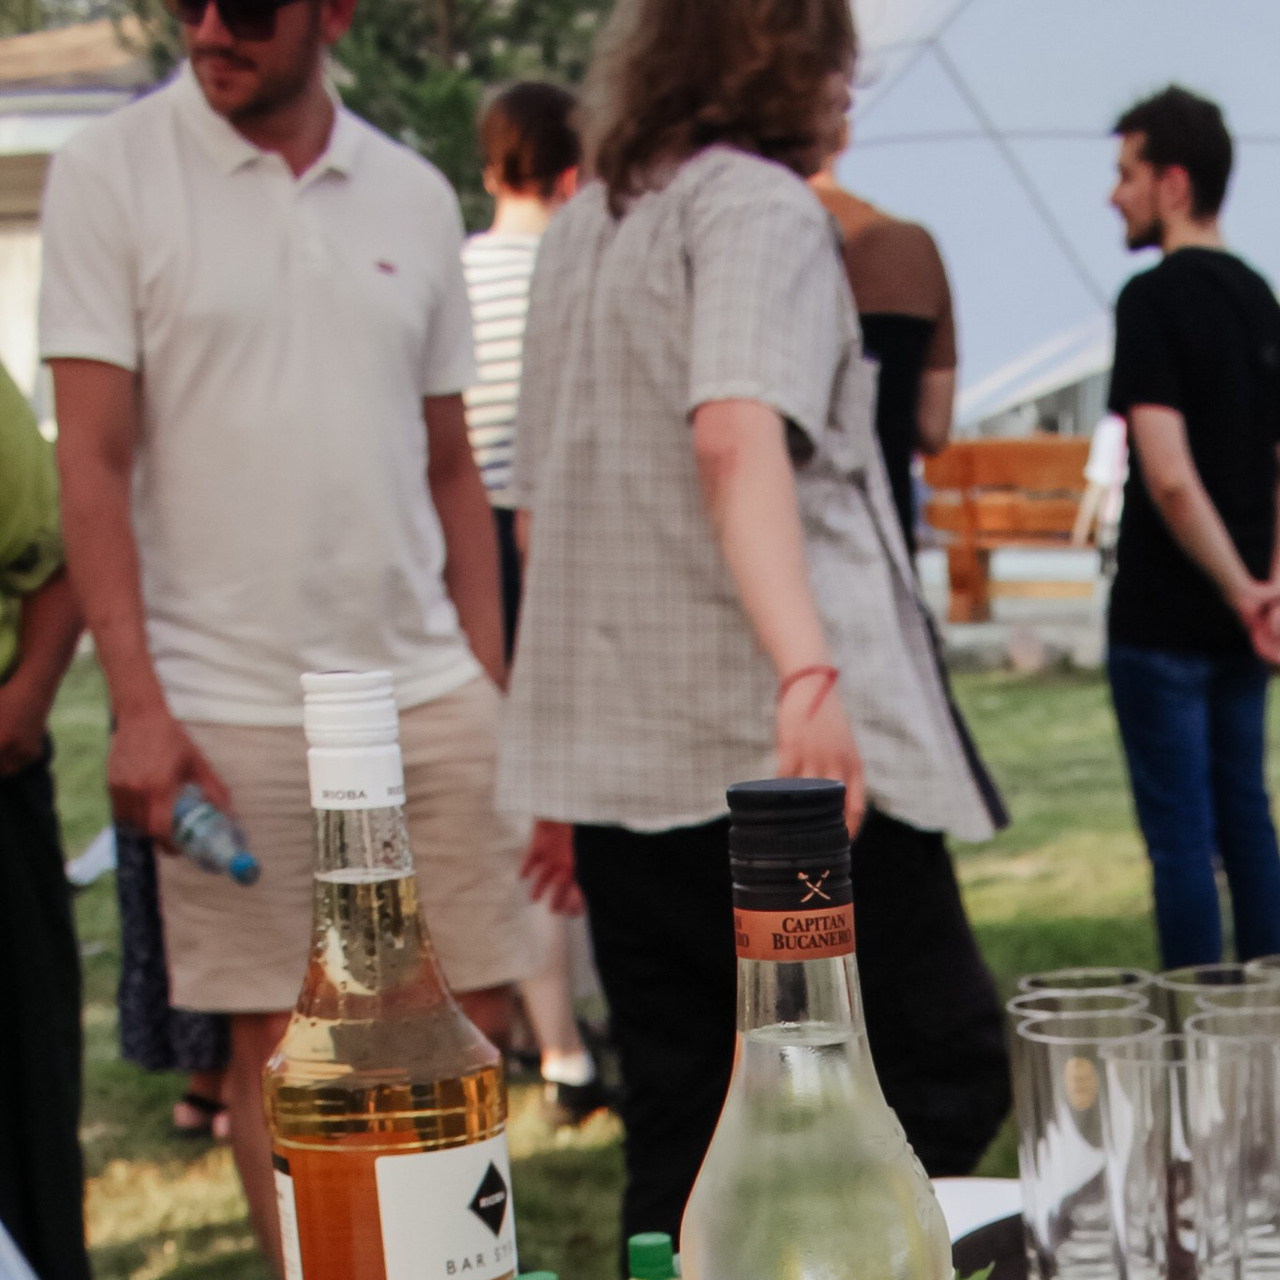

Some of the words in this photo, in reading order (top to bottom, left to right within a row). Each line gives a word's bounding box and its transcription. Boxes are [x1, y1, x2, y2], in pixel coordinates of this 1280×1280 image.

[322, 789, 367, 801] RIOBA
[781, 913, 846, 933] CAPITAN
[771, 928, 851, 950] BUCANERO
[446, 1253, 485, 1275] BAR
